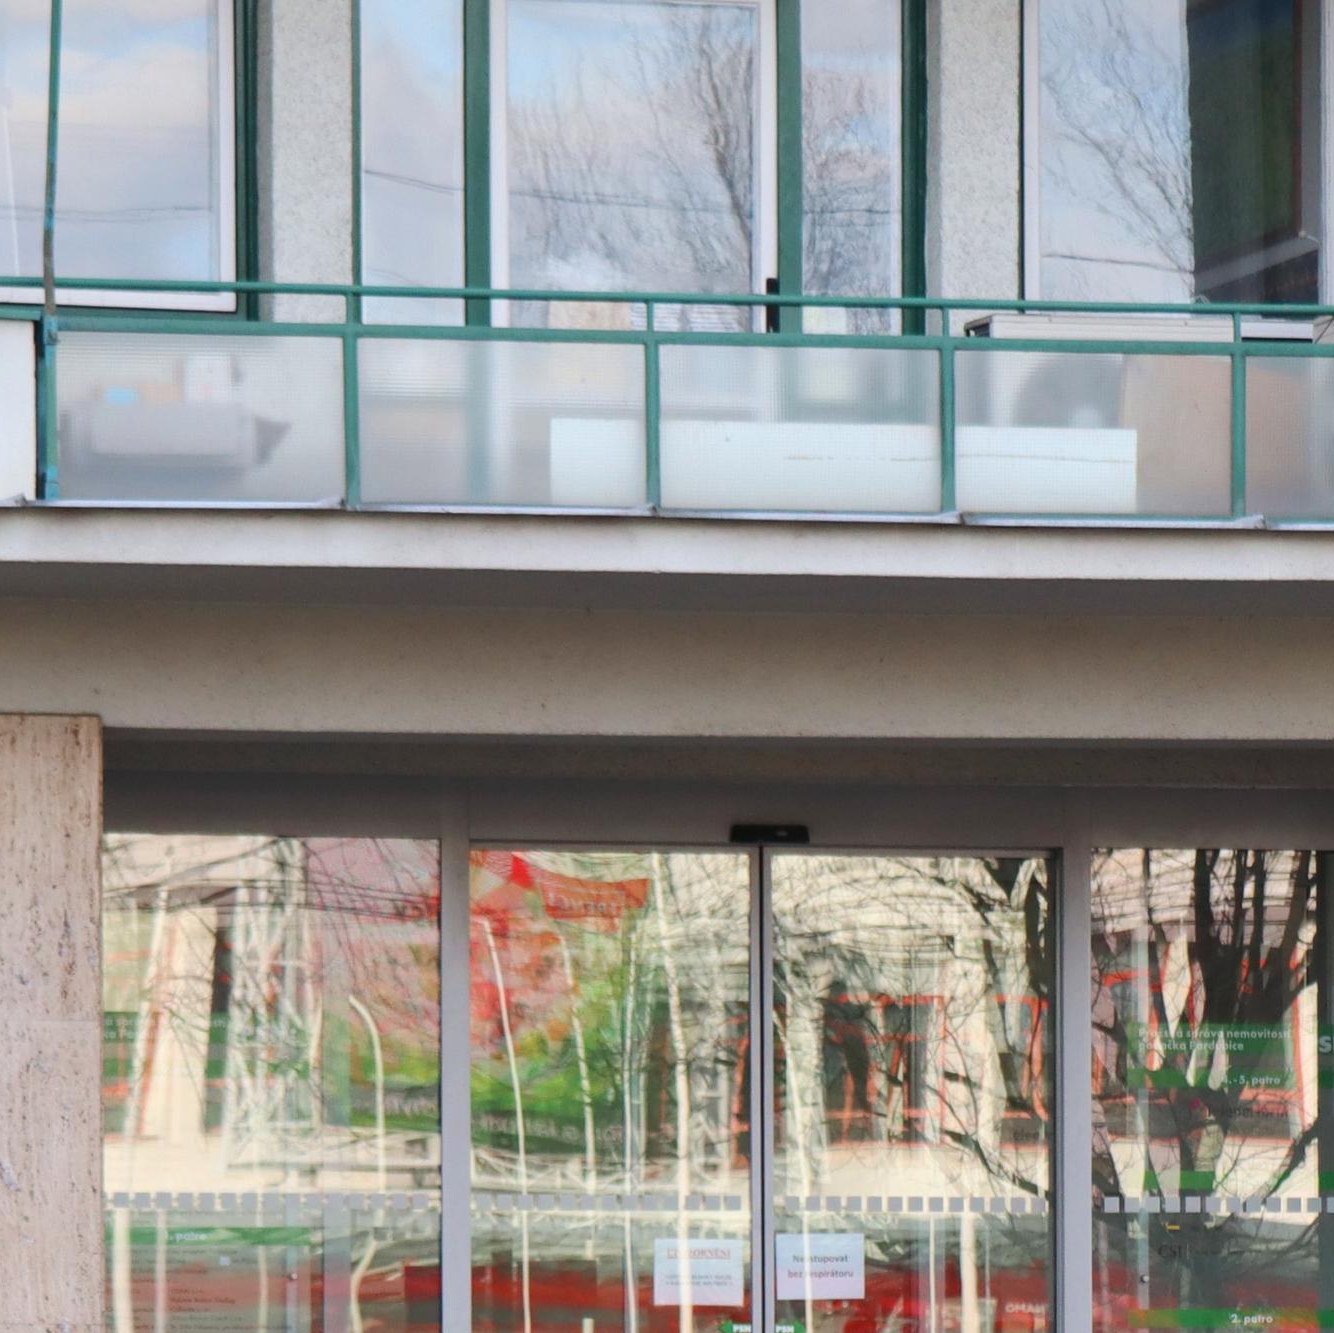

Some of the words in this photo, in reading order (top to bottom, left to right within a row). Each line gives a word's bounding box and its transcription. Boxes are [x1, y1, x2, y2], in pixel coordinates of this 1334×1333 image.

[793, 1254, 848, 1264] Nestupovat
[806, 1269, 854, 1280] espirátoru
[1244, 1313, 1273, 1325] patro
